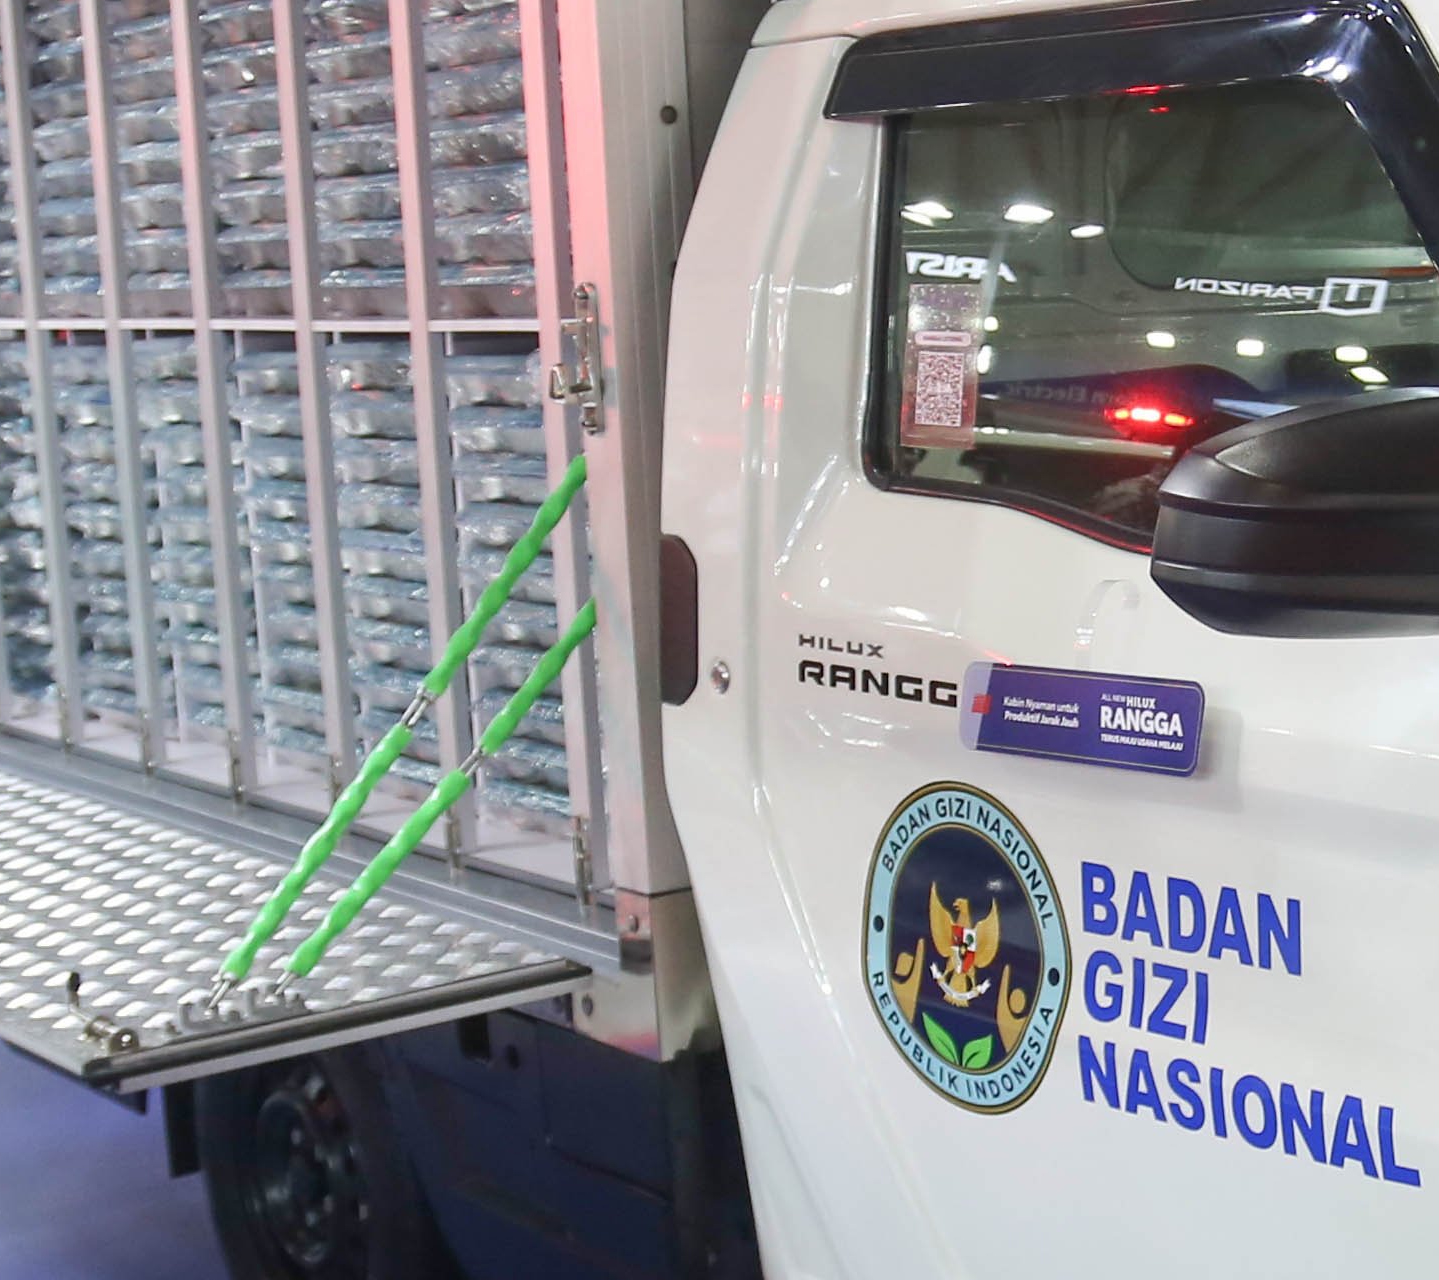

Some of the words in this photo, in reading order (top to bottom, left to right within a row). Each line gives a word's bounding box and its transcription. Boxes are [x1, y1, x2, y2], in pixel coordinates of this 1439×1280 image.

[798, 633, 884, 659] HILUX
[798, 659, 958, 708] RANGG
[1100, 693, 1112, 701] ALL
[1112, 695, 1126, 703] NEW
[1126, 696, 1156, 709] HILUX
[1003, 696, 1025, 707] Kabin
[1025, 698, 1056, 712] Nyaman
[1056, 702, 1080, 714] untuk
[1004, 710, 1040, 725] Produktif
[1040, 713, 1061, 726] Jarak
[1060, 715, 1079, 729] Jauh
[1100, 706, 1184, 737] RANGGA
[1100, 734, 1120, 744] TERUS
[1137, 738, 1158, 748] USAHA
[1158, 739, 1184, 751] MELAJU
[881, 801, 931, 873] BADAN
[935, 797, 972, 819] GIZI
[976, 805, 1055, 930] NASIONAL
[1080, 860, 1302, 977] BADAN
[1083, 949, 1209, 1046] GIZI
[872, 971, 960, 1093] REPUBLIK
[966, 1006, 1054, 1099] INDONESIA
[1077, 1034, 1422, 1188] NASIONAL
